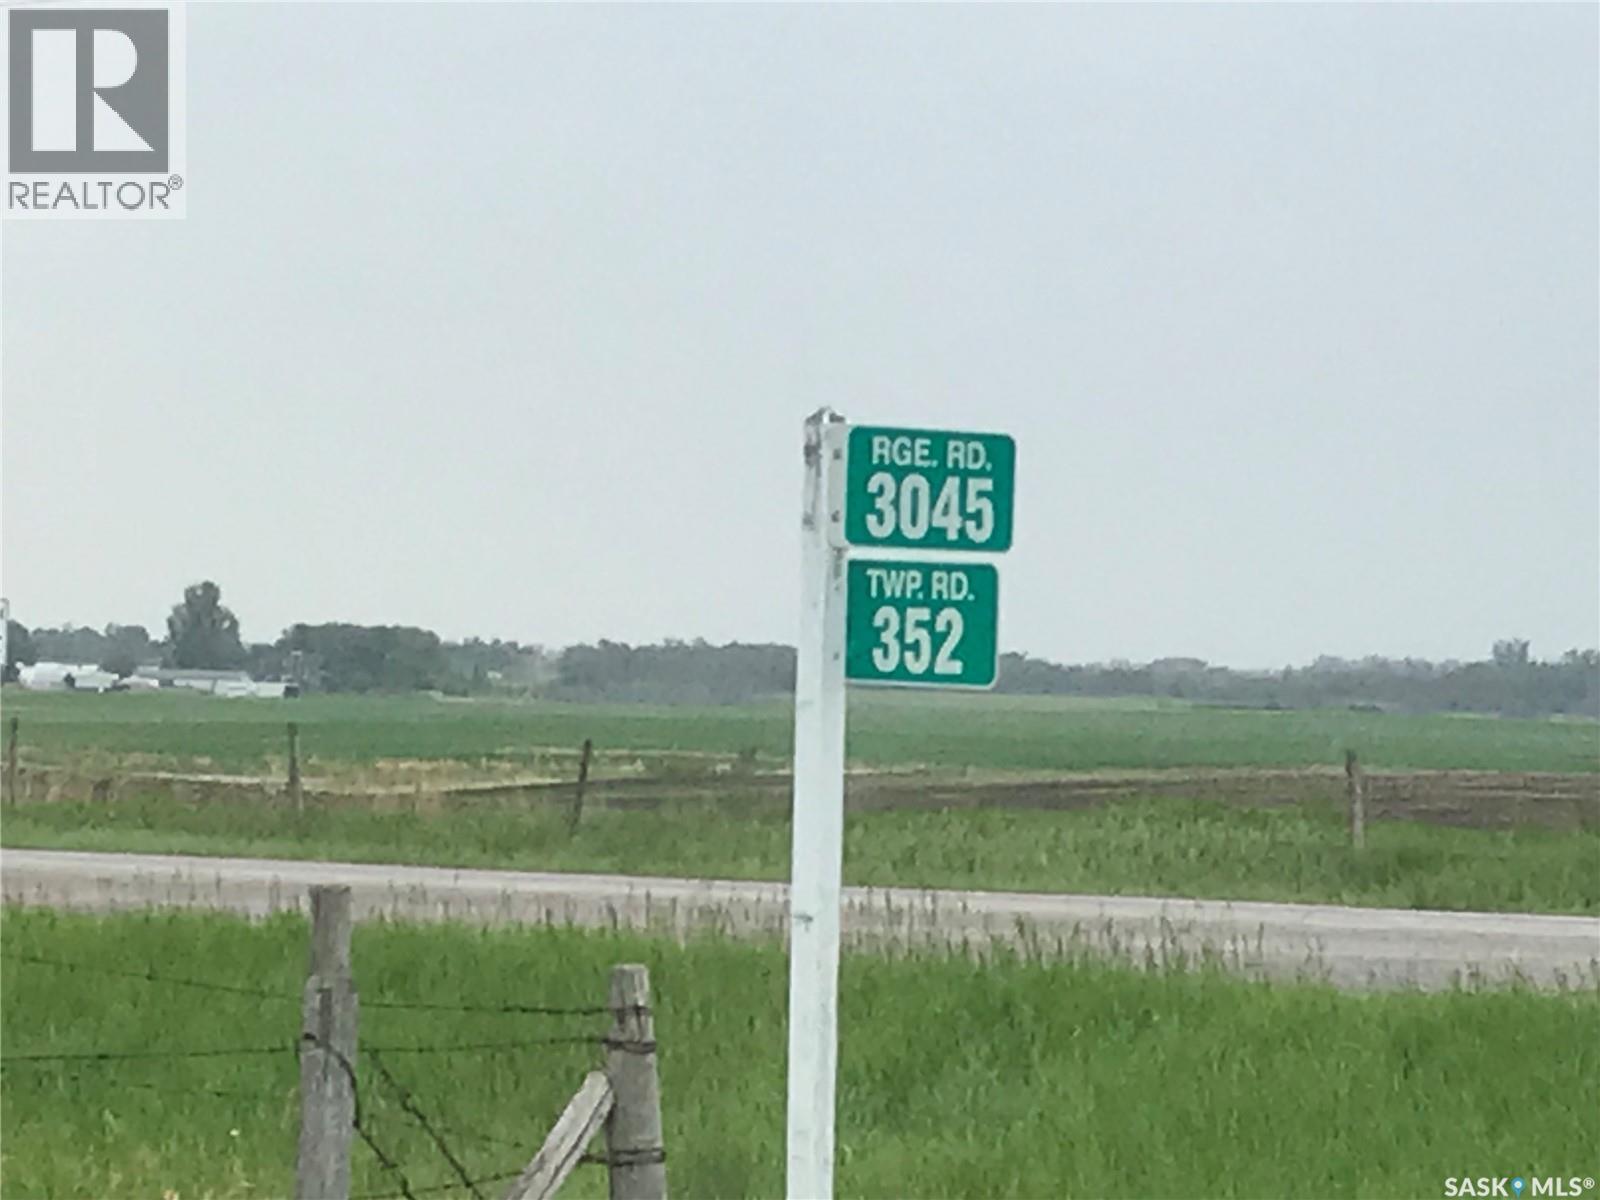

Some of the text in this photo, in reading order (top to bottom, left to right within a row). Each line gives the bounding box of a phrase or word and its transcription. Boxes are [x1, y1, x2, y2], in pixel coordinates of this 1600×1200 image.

[872, 435, 992, 471] RGE. RD.
[865, 471, 995, 543] 3045
[866, 568, 975, 601] TWP. RD.
[872, 605, 964, 675] 352
